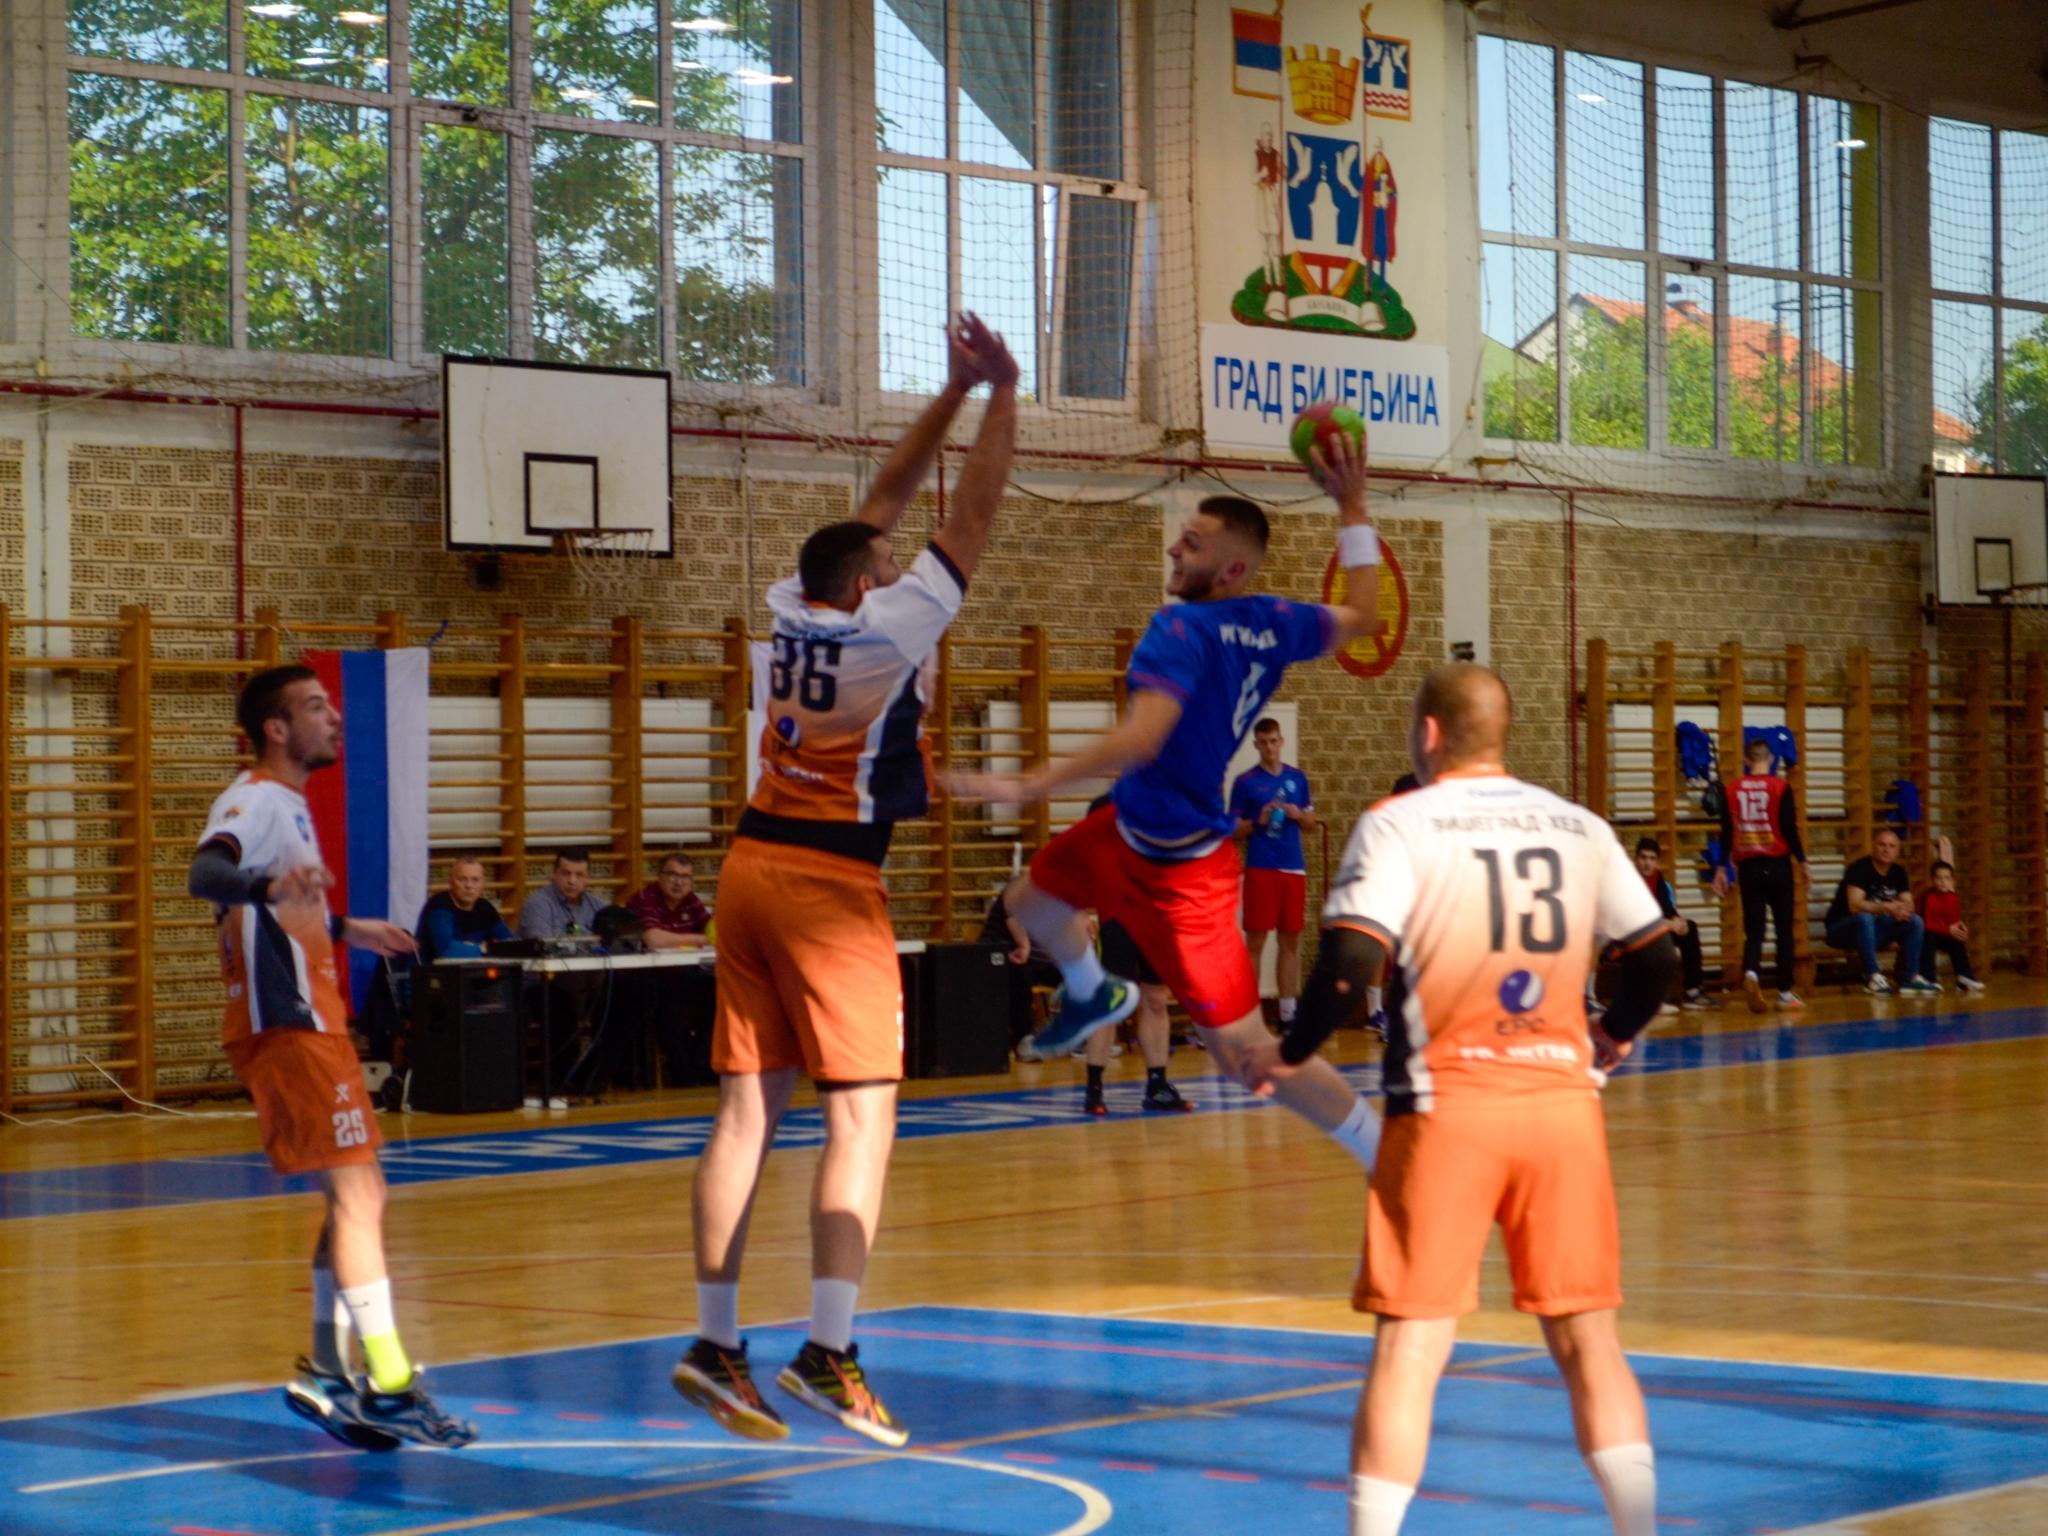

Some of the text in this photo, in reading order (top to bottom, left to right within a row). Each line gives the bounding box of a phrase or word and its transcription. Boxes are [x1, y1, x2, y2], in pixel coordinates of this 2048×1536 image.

[1214, 356, 1439, 427] ГРАД БИЈЕЉИНА
[770, 632, 842, 713] 36
[1736, 790, 1769, 821] 12
[1472, 847, 1567, 953] 13
[331, 1109, 368, 1149] 25
